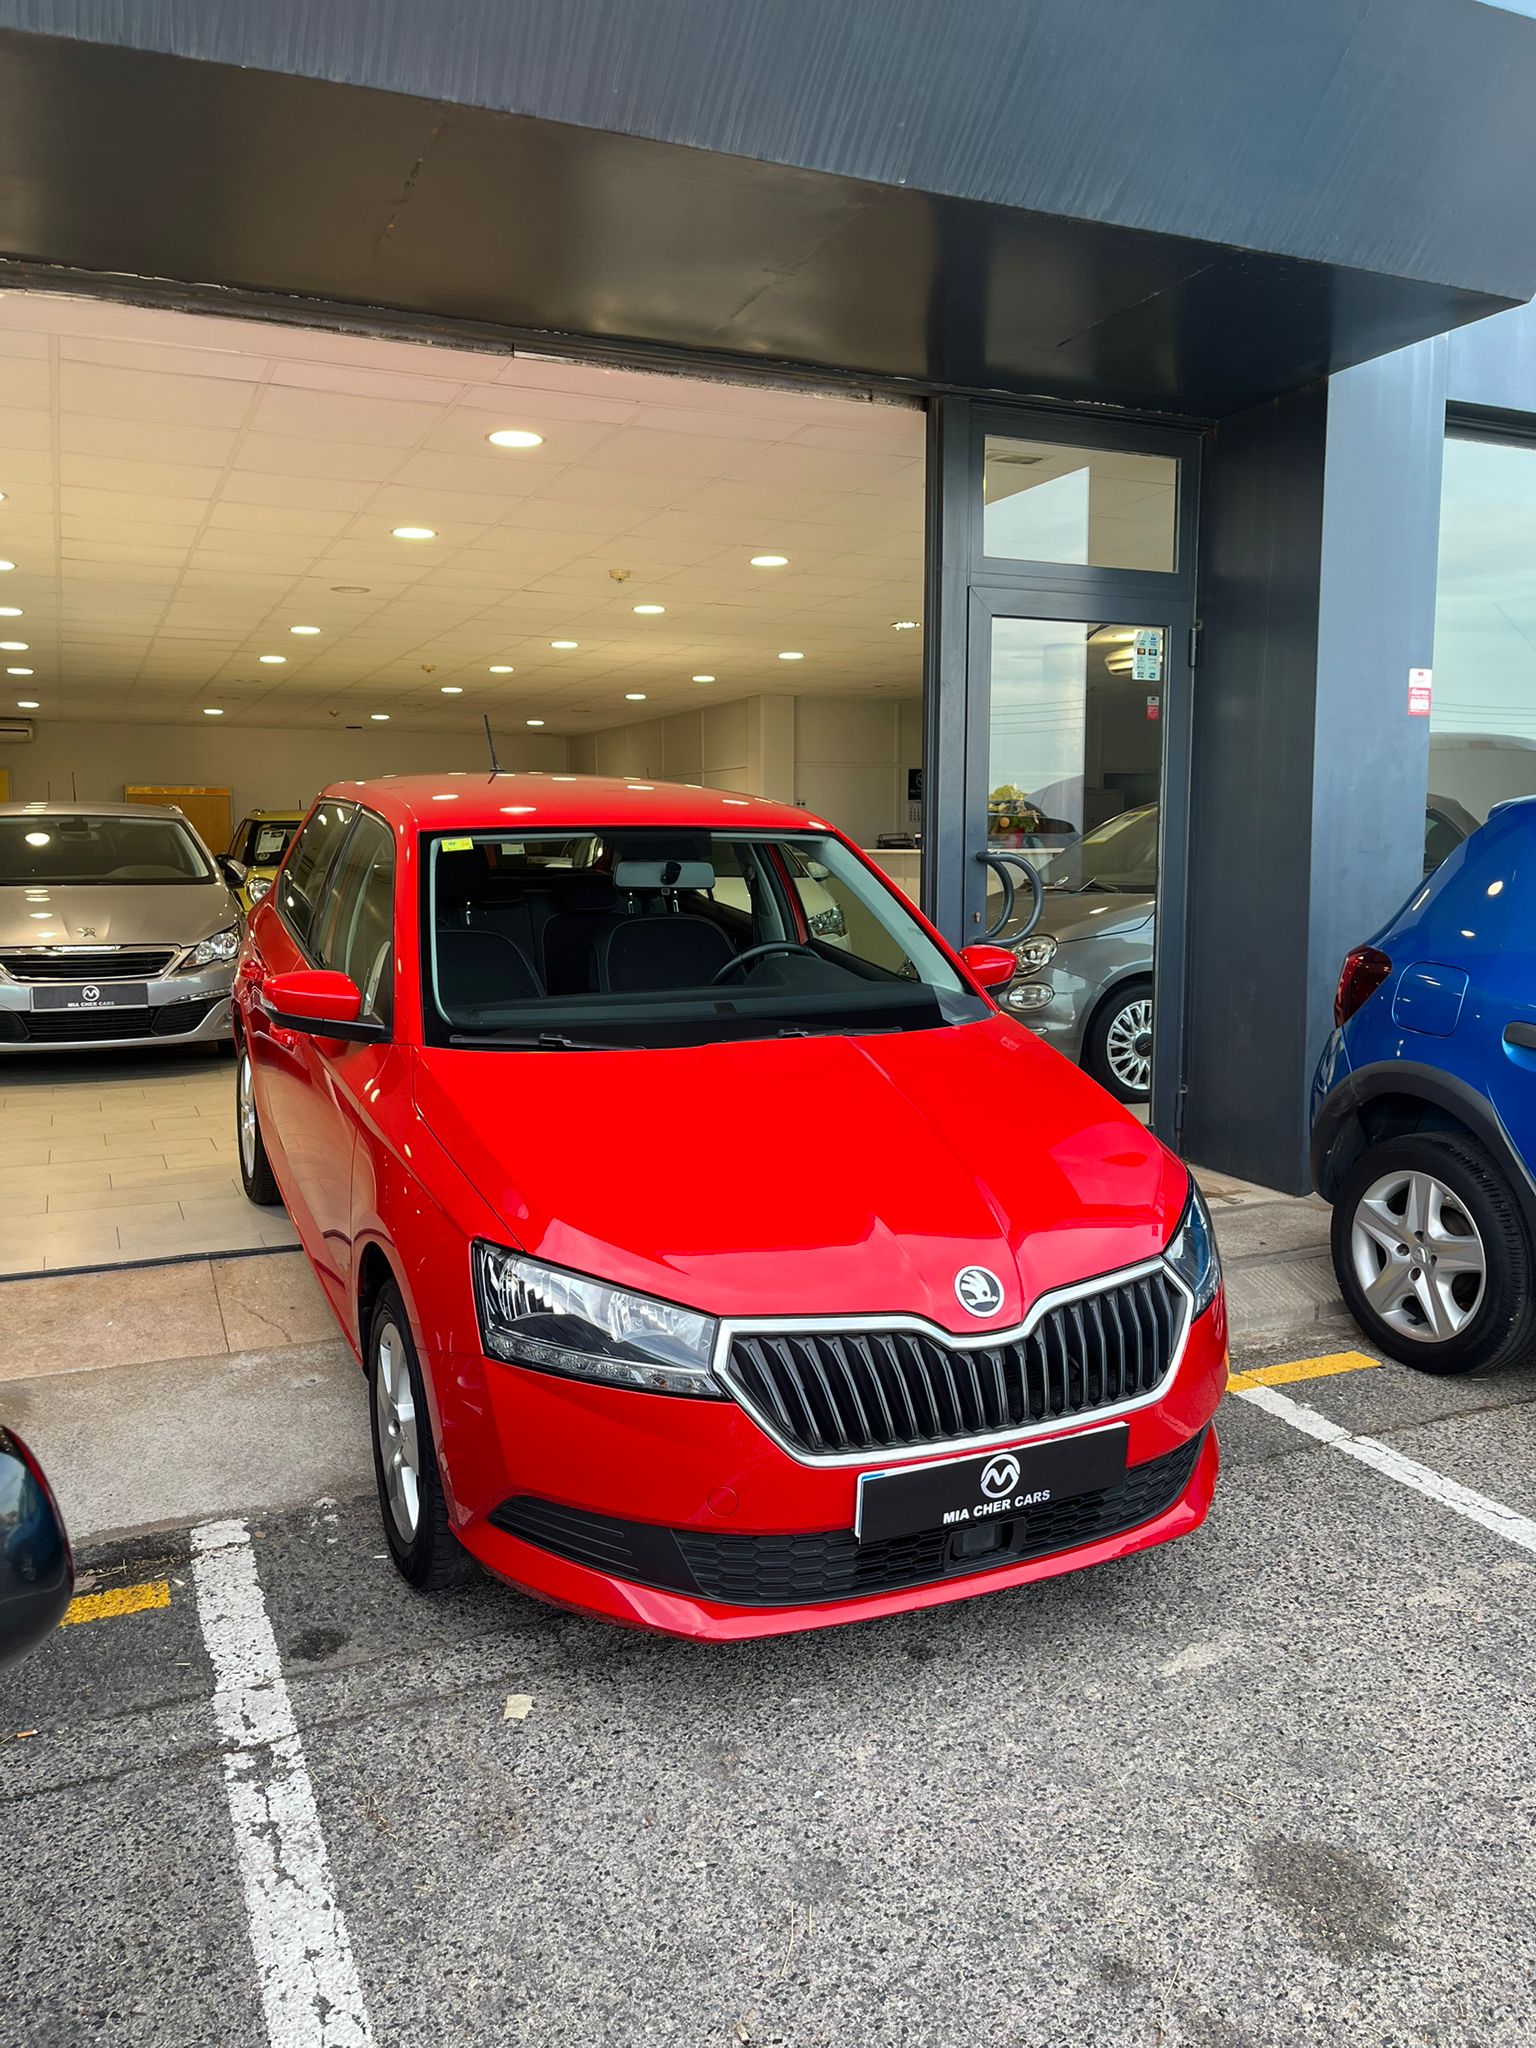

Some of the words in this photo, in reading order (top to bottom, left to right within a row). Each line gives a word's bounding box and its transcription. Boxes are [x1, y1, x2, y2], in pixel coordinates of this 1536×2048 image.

[943, 1508, 970, 1524] MIA
[973, 1499, 1011, 1517] CHER
[1014, 1489, 1051, 1507] CARS
